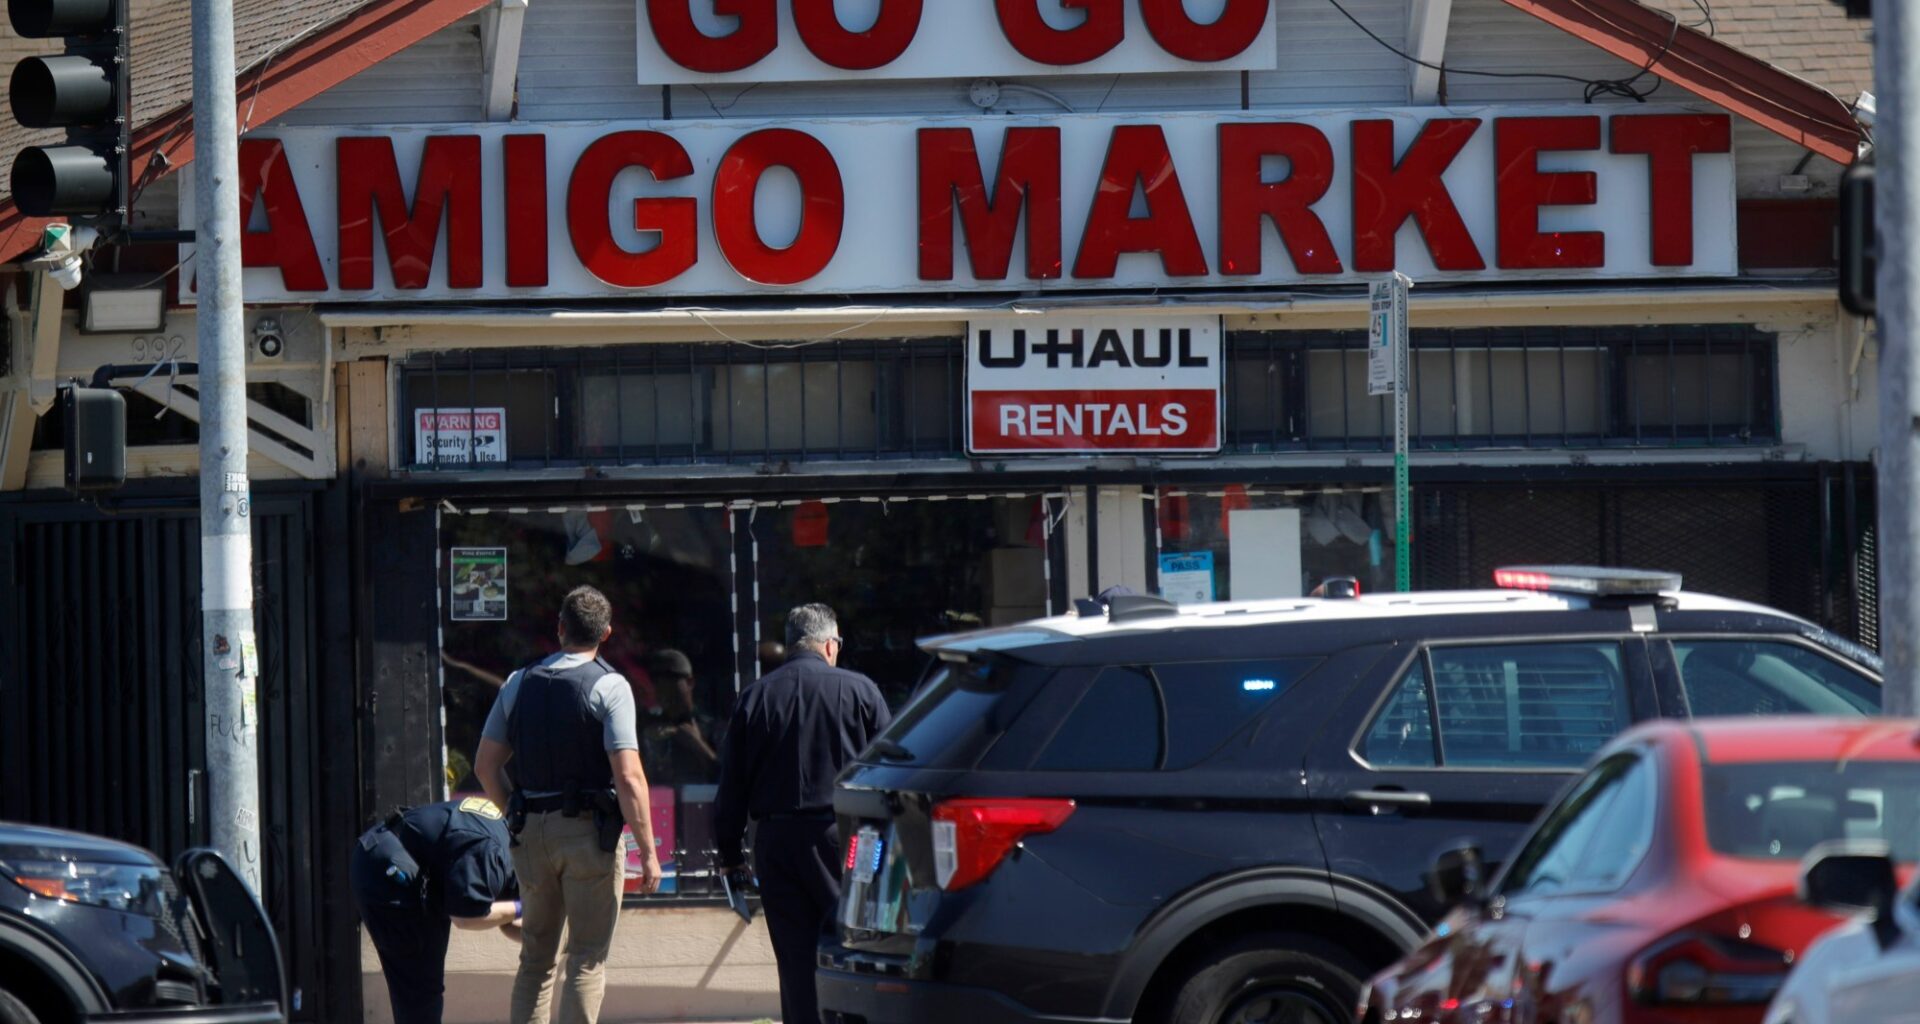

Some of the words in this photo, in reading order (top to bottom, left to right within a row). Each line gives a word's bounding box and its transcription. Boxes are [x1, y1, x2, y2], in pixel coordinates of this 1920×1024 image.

[190, 128, 845, 291] AMIGO
[916, 114, 1732, 281] MARKET
[131, 335, 188, 362] 992
[978, 328, 1209, 369] U-HAUL
[424, 415, 497, 429] WARNNG
[1000, 403, 1188, 437] RENTALS
[426, 452, 466, 464] Cmeras
[1171, 560, 1200, 571] PASS
